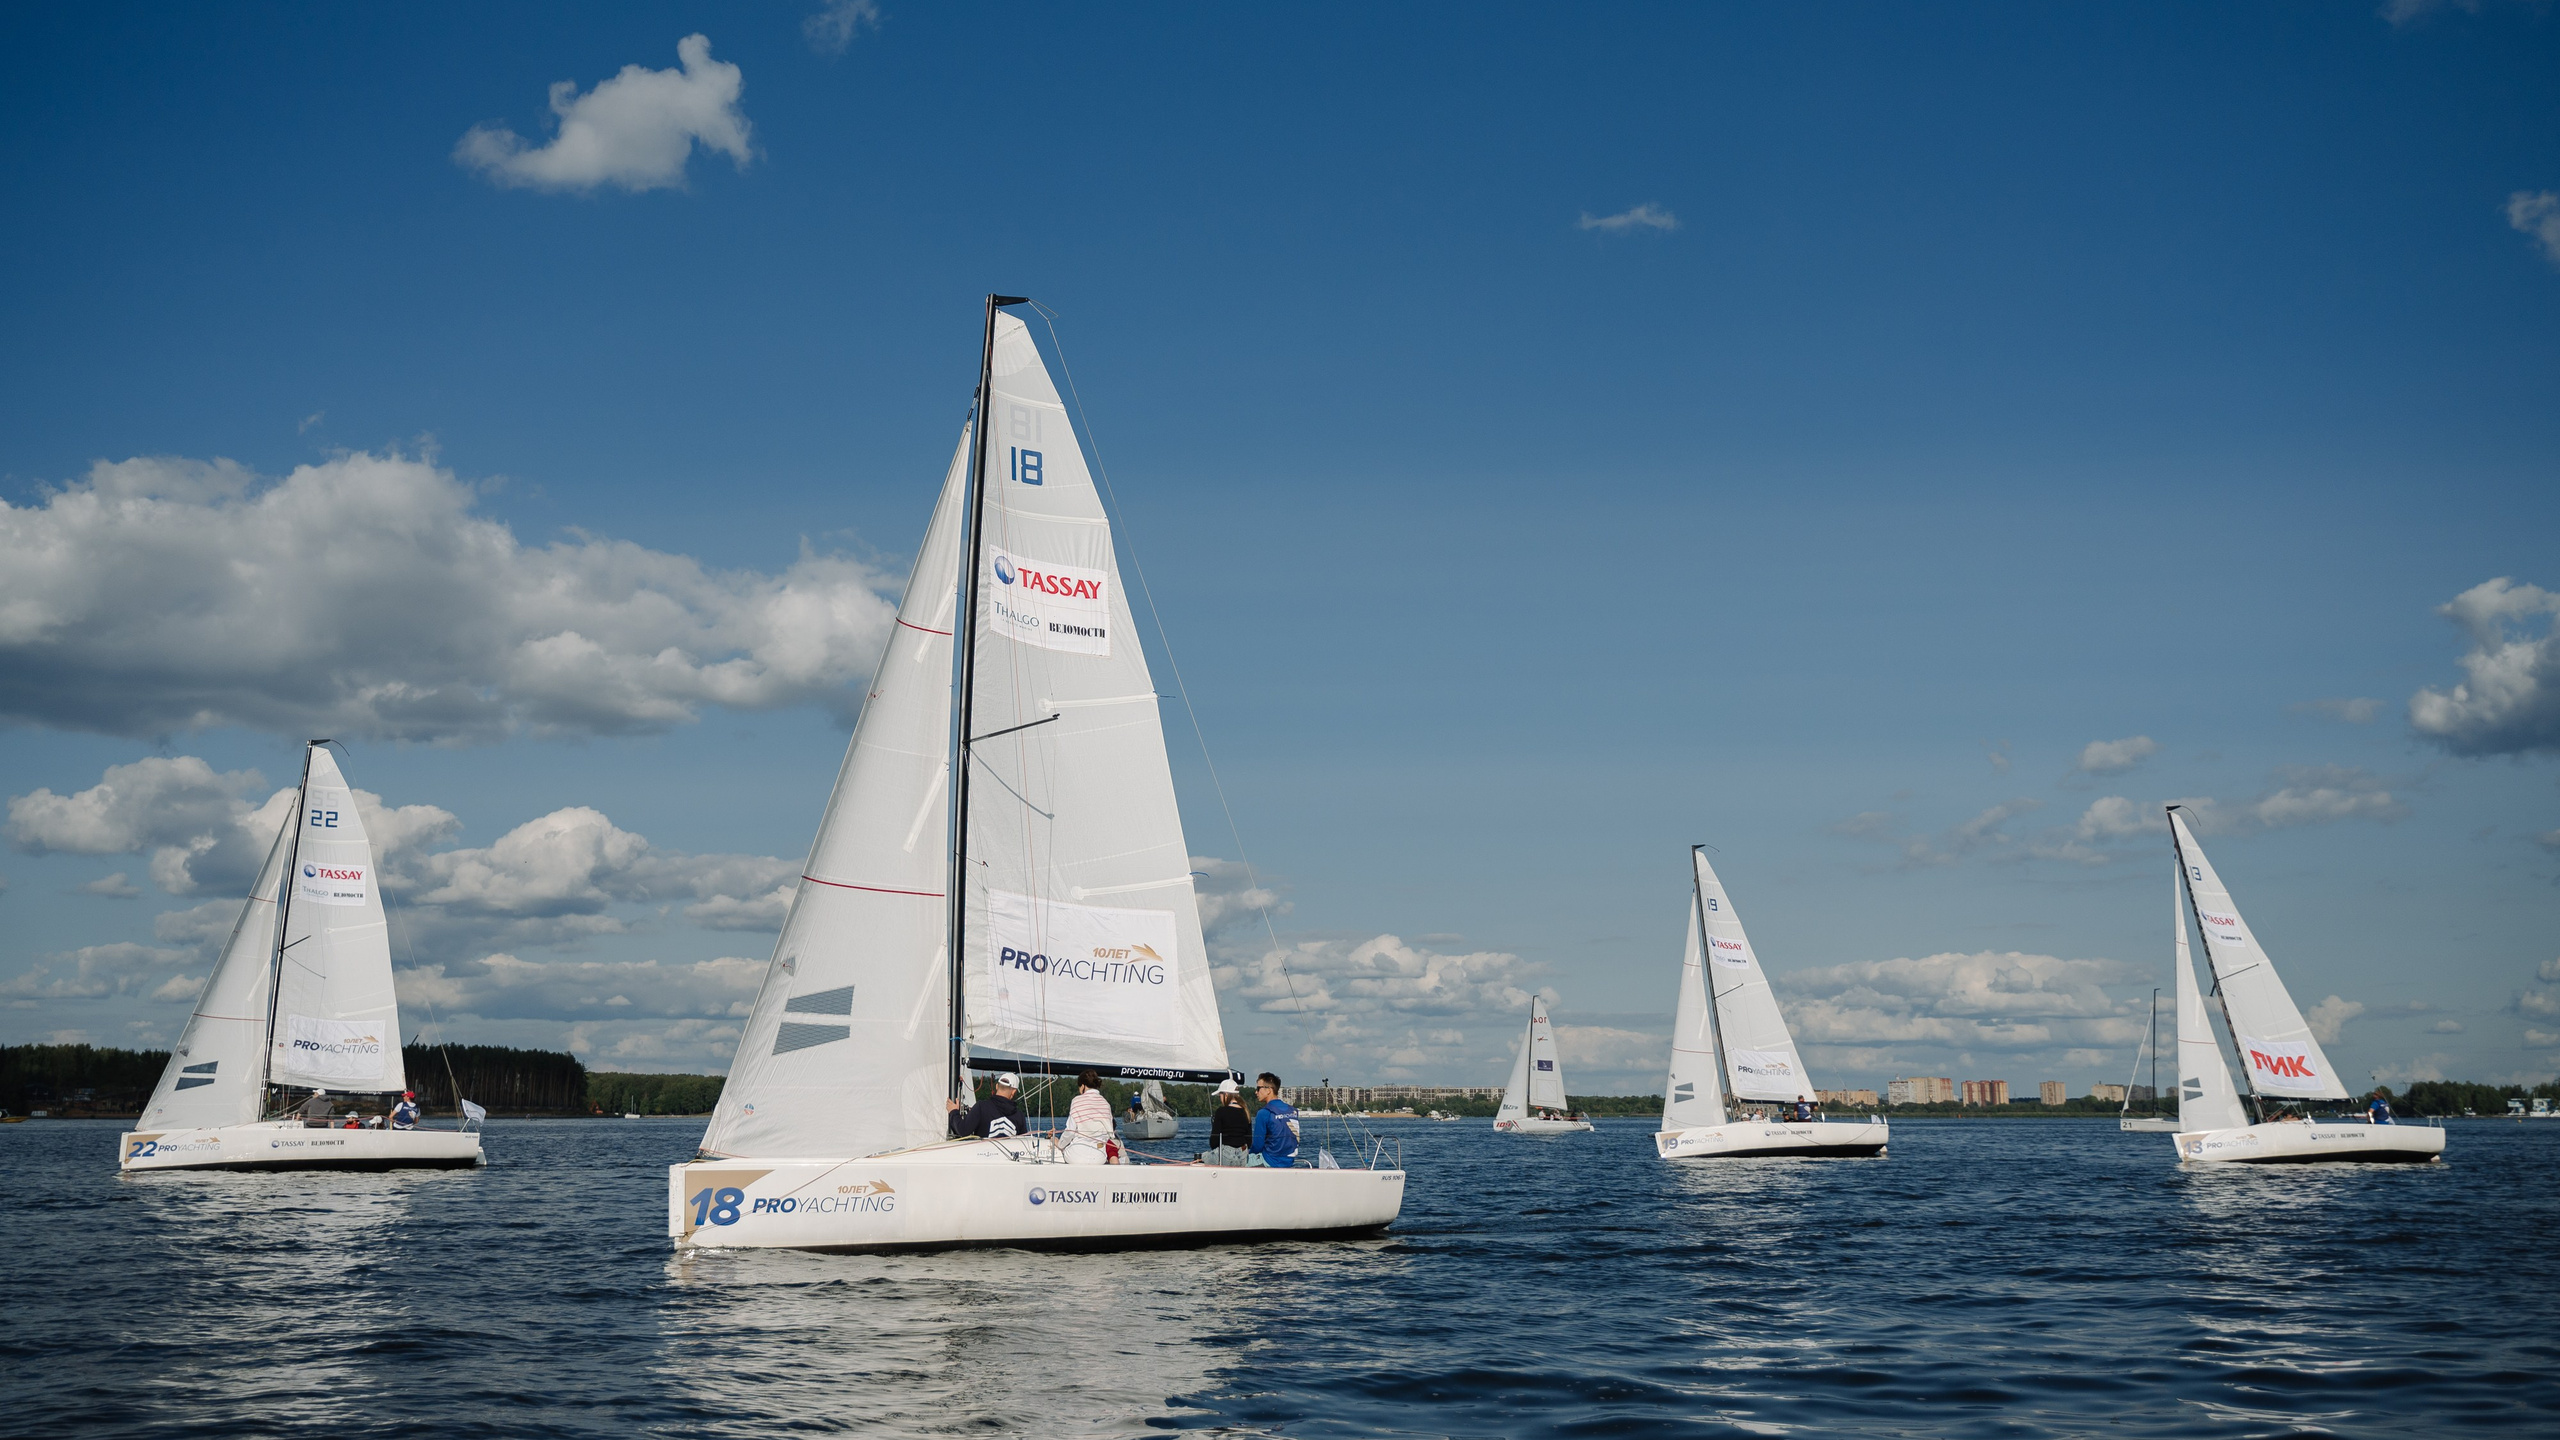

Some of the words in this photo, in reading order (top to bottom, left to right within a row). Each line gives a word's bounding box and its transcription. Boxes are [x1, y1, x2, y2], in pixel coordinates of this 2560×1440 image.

[1010, 446, 1043, 486] 18
[1017, 567, 1102, 599] TASSAY
[994, 601, 1040, 627] THALGO
[1049, 622, 1106, 639] ВЕДОМОСТИ
[311, 809, 338, 828] 22
[318, 868, 364, 880] TASSAY
[2189, 865, 2202, 881] 13
[1707, 897, 1718, 911] 19
[2206, 914, 2235, 926] TASSAY
[1716, 940, 1742, 951] TASSAY
[999, 946, 1165, 985] PROYACHTING
[293, 1039, 379, 1054] PROYACHTING
[2250, 1049, 2315, 1077] ПИК
[1120, 1067, 1185, 1080] pro-yachting.ru
[1738, 1065, 1790, 1076] PROYACHTING
[2122, 1121, 2132, 1129] 21
[128, 1141, 158, 1157] 22
[158, 1143, 221, 1152] PROYACHTING
[1663, 1137, 1678, 1149] 19
[2184, 1140, 2203, 1154] 13
[2206, 1139, 2259, 1149] PROYACHTING
[1049, 1190, 1100, 1203] TASSAY
[1112, 1191, 1178, 1205] ВЕДОМОСТИ
[690, 1187, 745, 1226] 18
[752, 1196, 895, 1213] PROYACHTING
